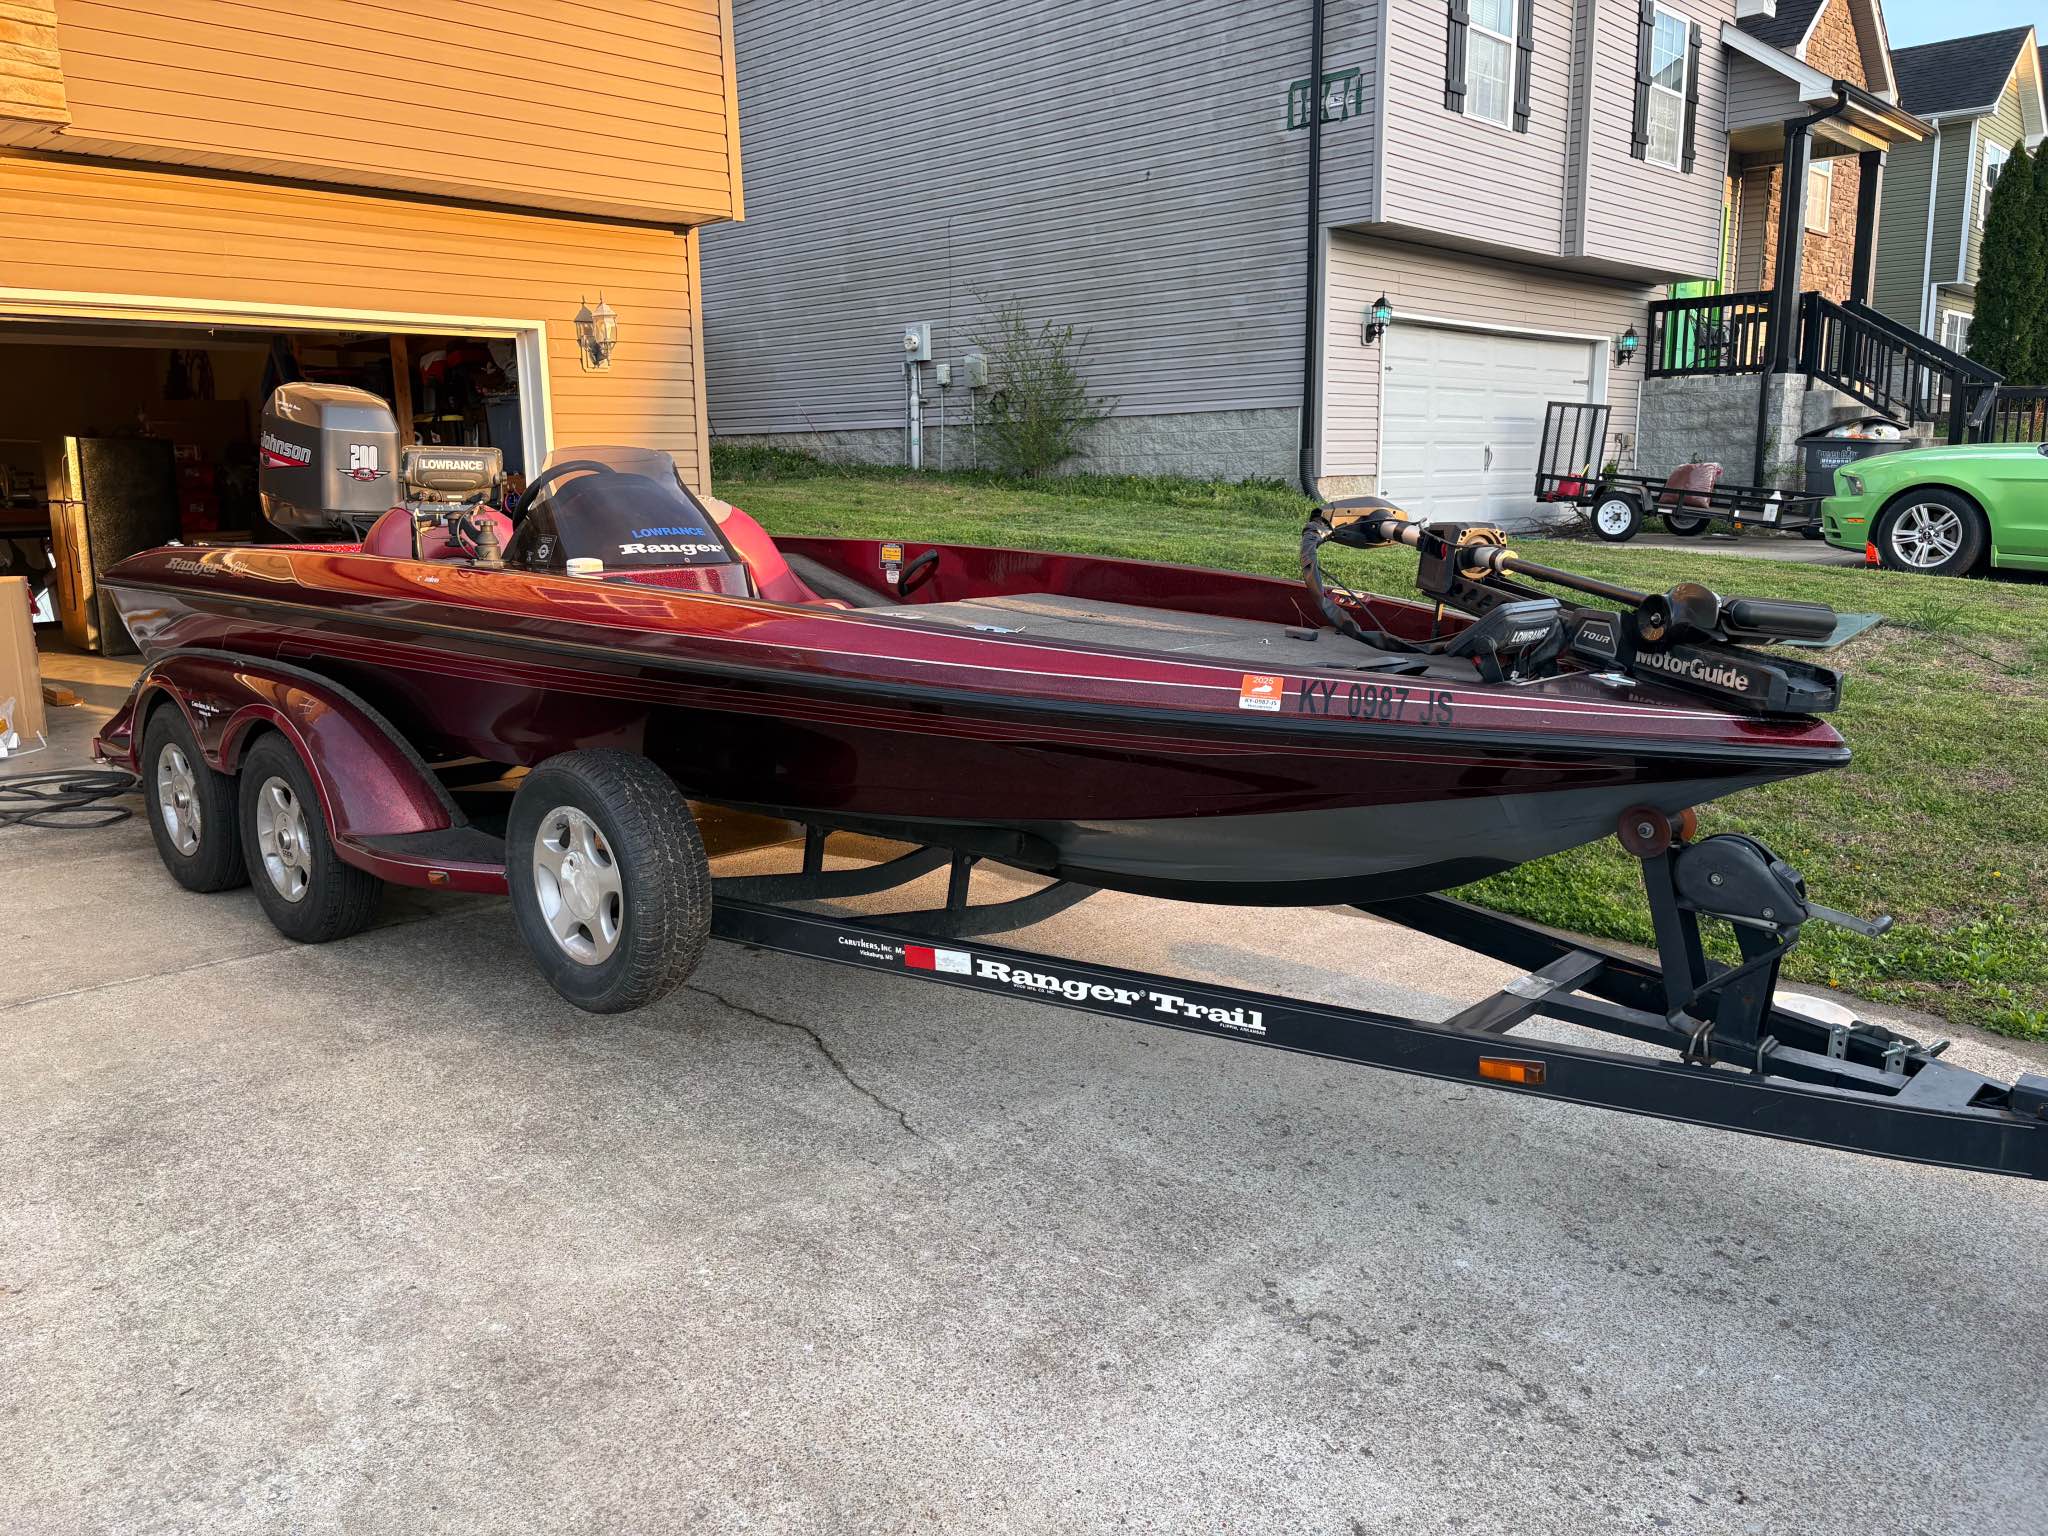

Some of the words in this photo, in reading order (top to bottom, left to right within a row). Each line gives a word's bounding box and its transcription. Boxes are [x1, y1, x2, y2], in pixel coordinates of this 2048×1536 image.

[261, 431, 312, 464] Johnson
[350, 444, 378, 470] 200
[422, 459, 485, 470] LOWRANCE
[631, 527, 705, 539] LOWRANCE
[618, 543, 722, 556] Ranger
[165, 557, 222, 575] Ranger
[1582, 630, 1611, 644] TOUR
[1635, 650, 1750, 691] MotorGuide
[1299, 679, 1338, 714] KY
[1348, 683, 1409, 720] 0987
[1419, 689, 1453, 726] JS
[976, 958, 1140, 1006] Ranger
[1149, 991, 1267, 1031] Trail
